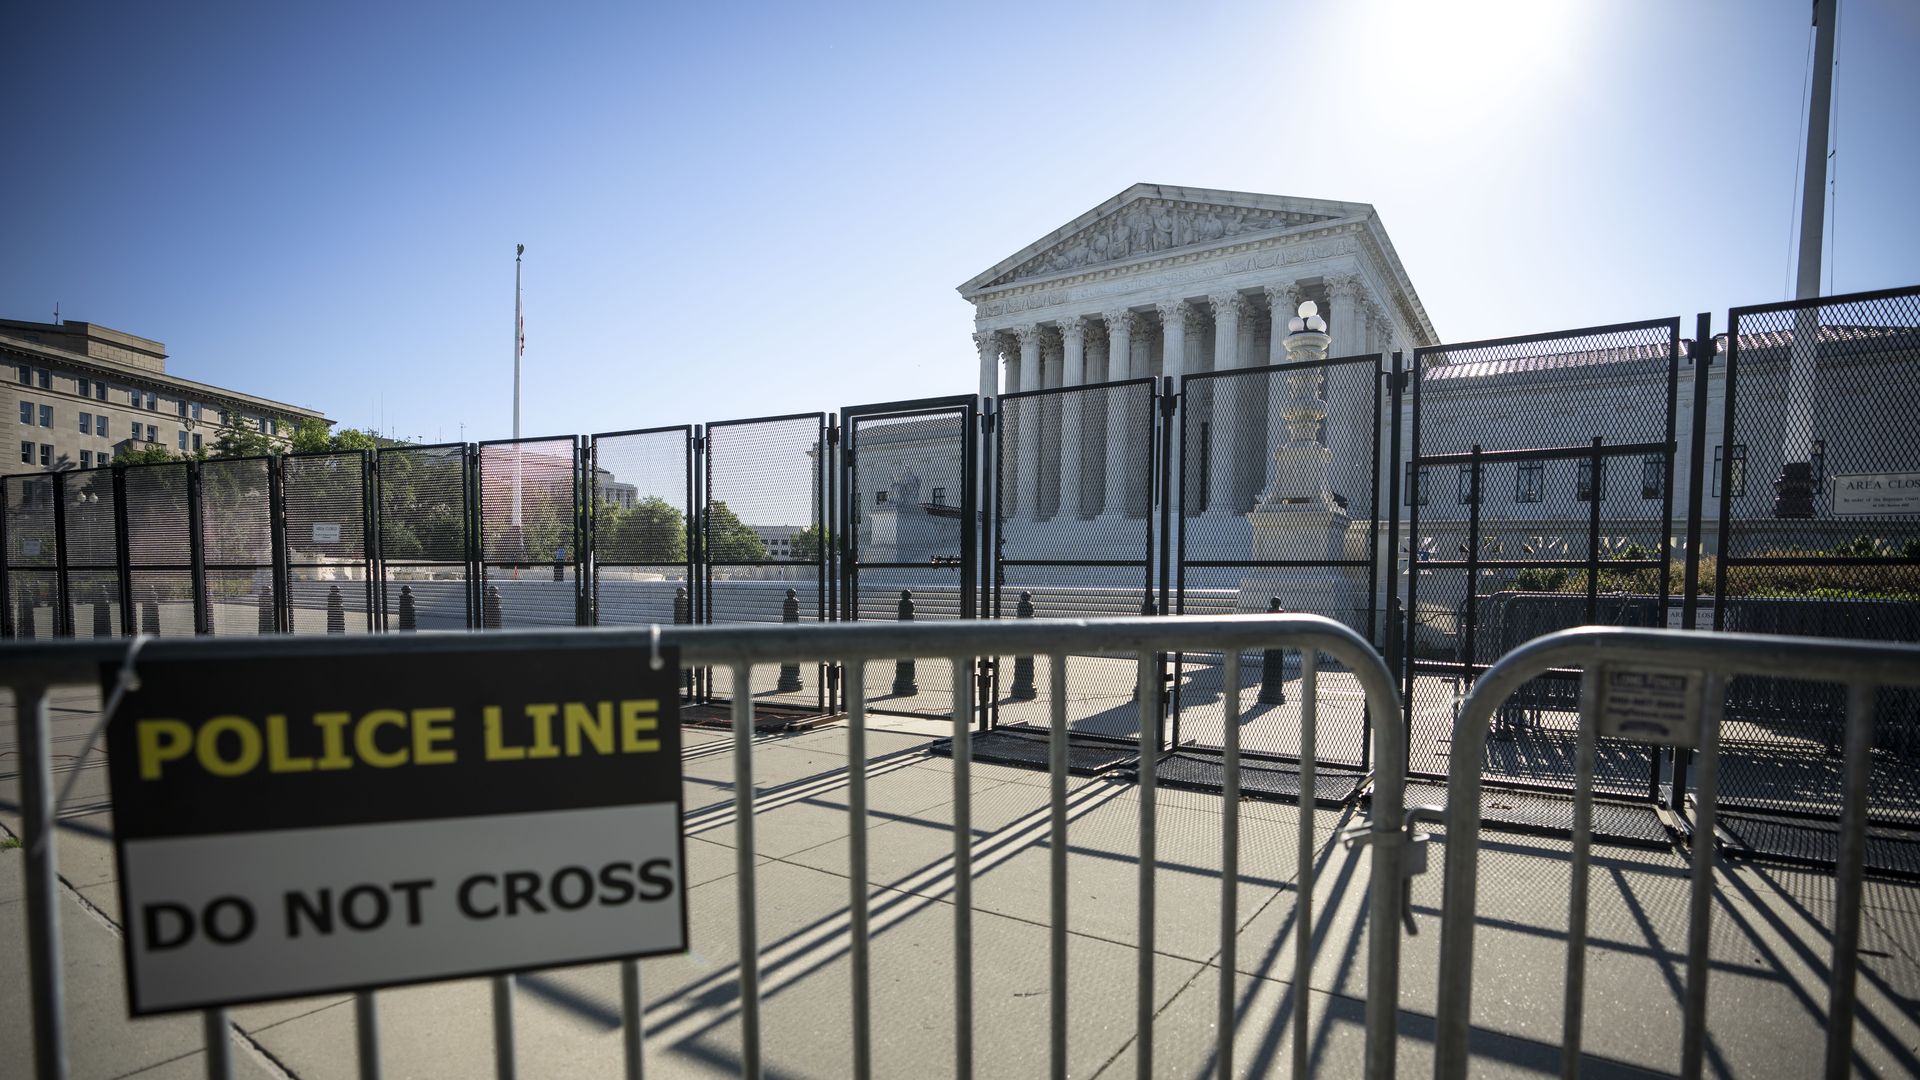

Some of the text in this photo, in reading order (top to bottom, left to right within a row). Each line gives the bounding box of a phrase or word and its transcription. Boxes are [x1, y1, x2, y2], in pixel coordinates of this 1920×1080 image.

[1846, 481, 1882, 490] AREA
[137, 698, 662, 780] POLICE LINE
[140, 858, 675, 955] DO NOT CROSS
